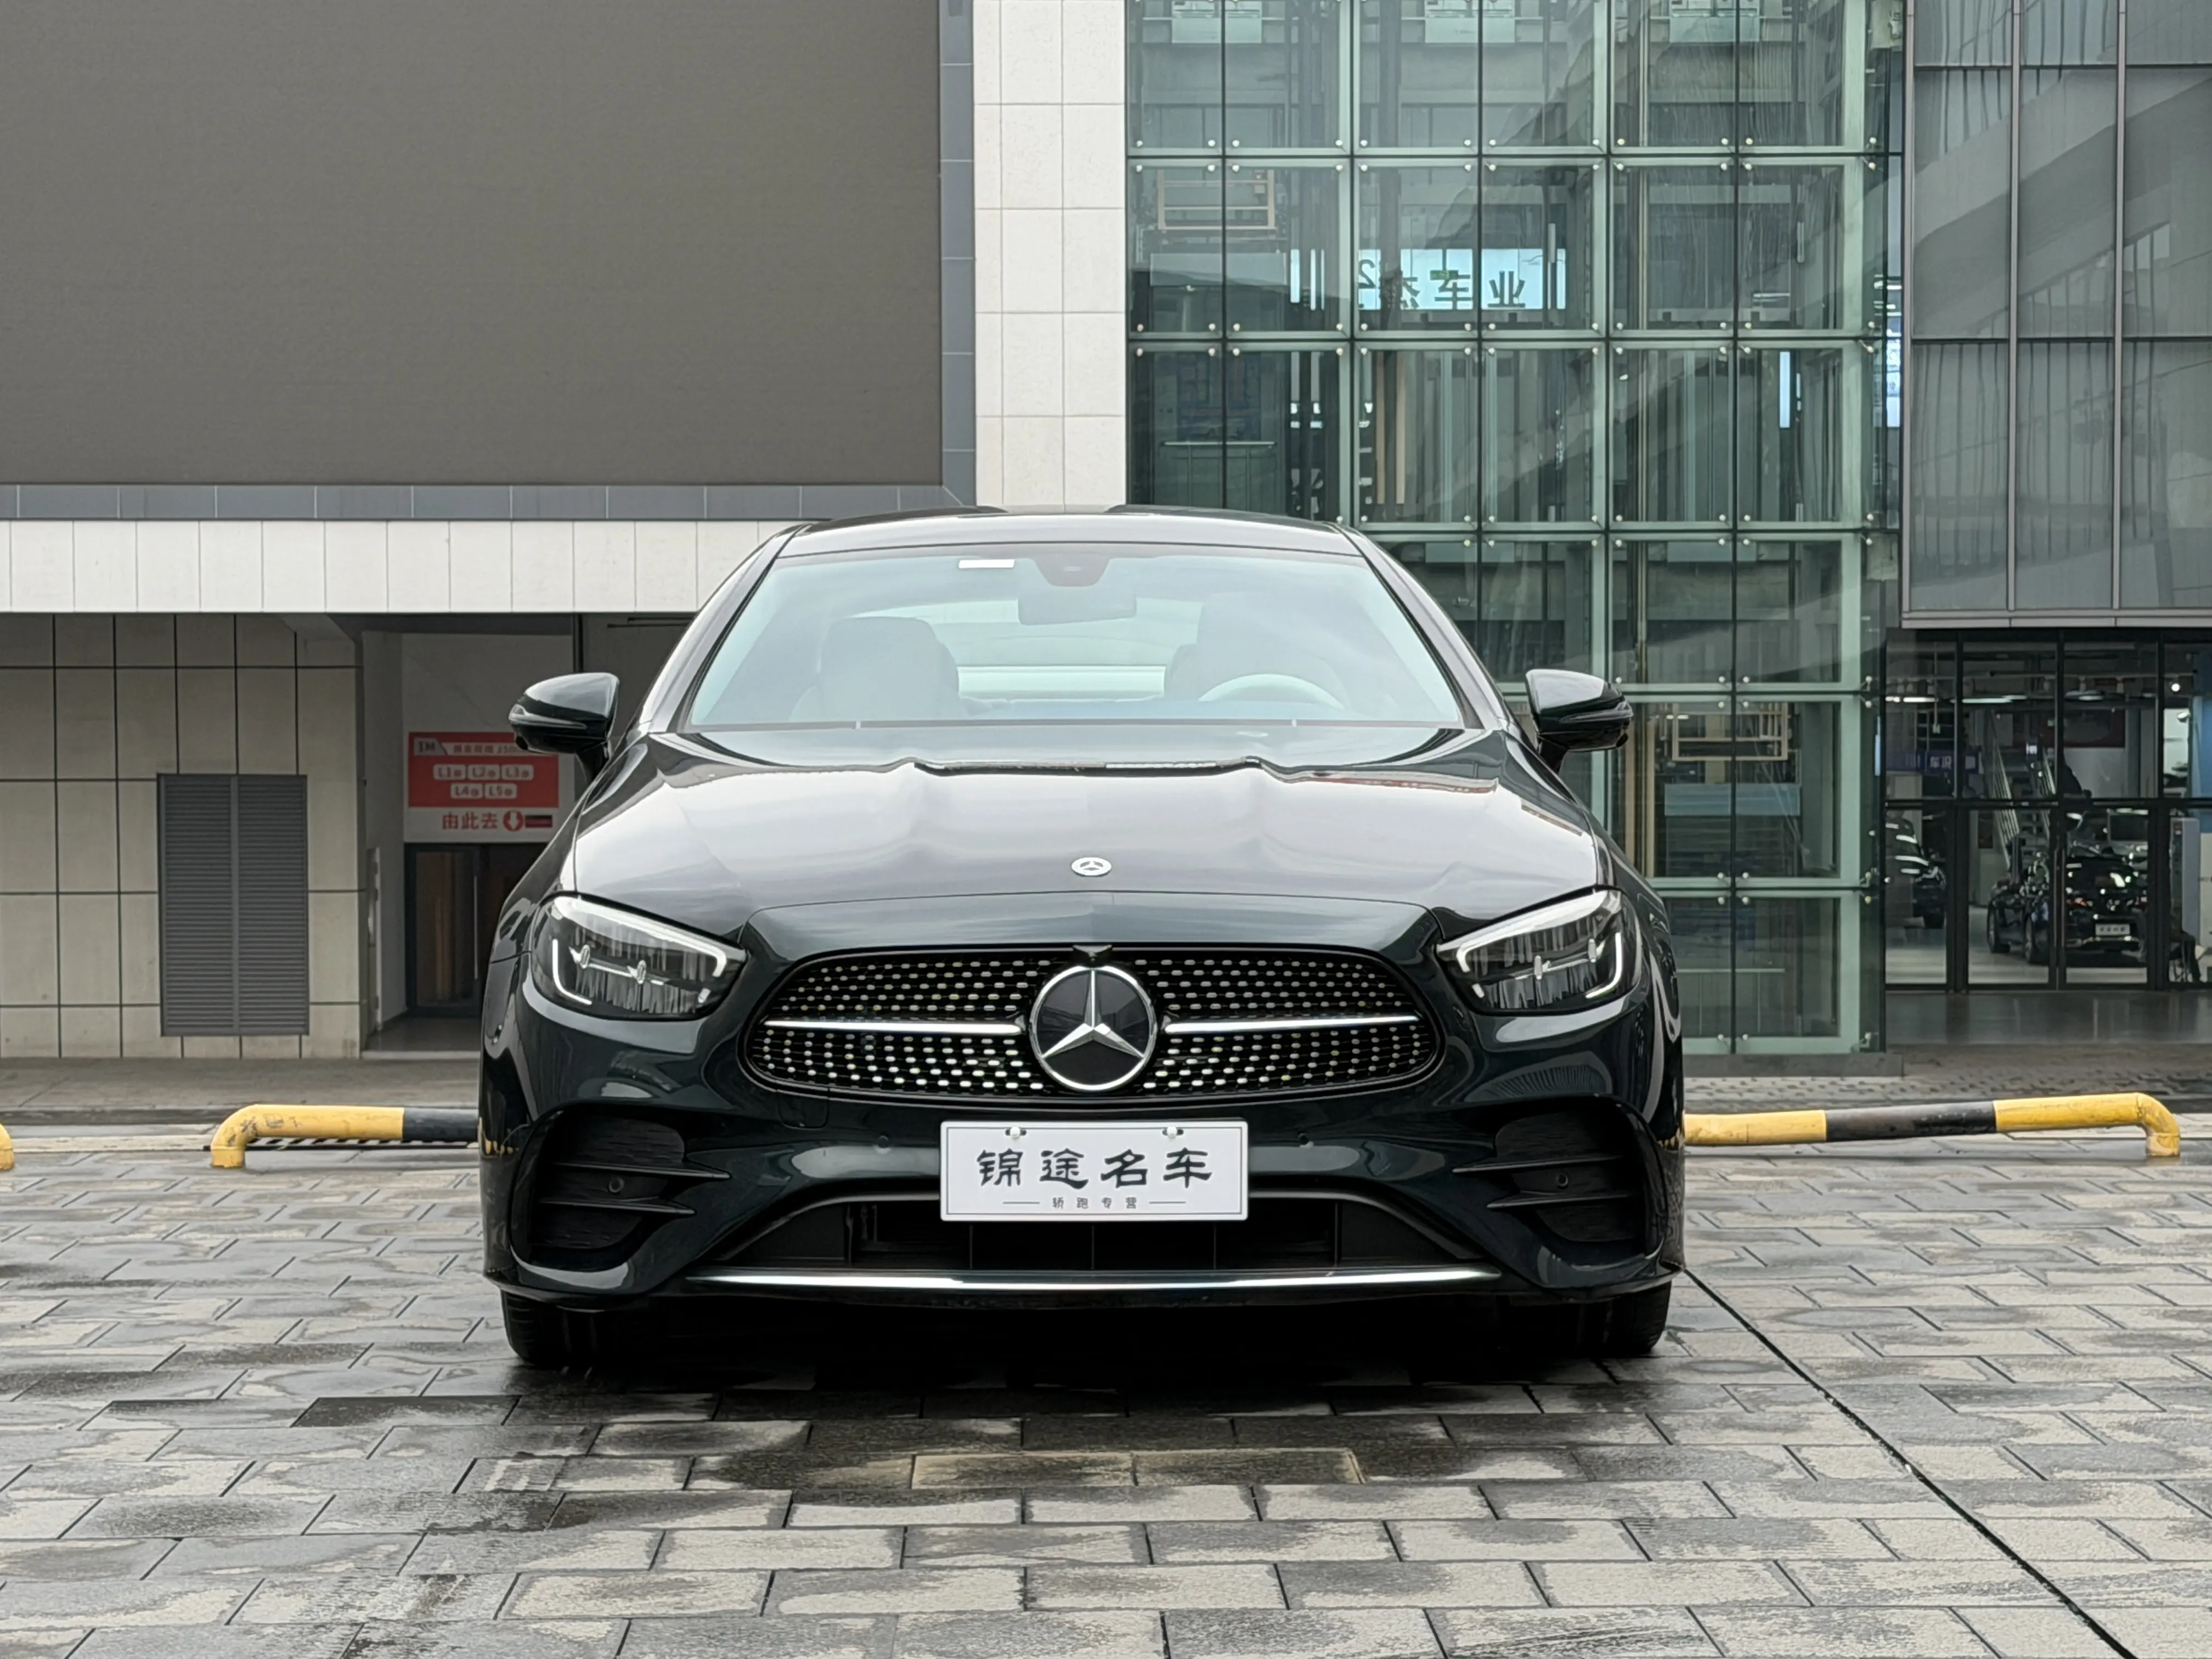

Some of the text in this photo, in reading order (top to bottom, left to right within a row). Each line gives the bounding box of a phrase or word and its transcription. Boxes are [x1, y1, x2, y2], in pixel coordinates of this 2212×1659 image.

[442, 812, 498, 830] 由此去
[976, 1147, 1213, 1189] 锦途名车
[1052, 1197, 1138, 1210] 轿跑专营
